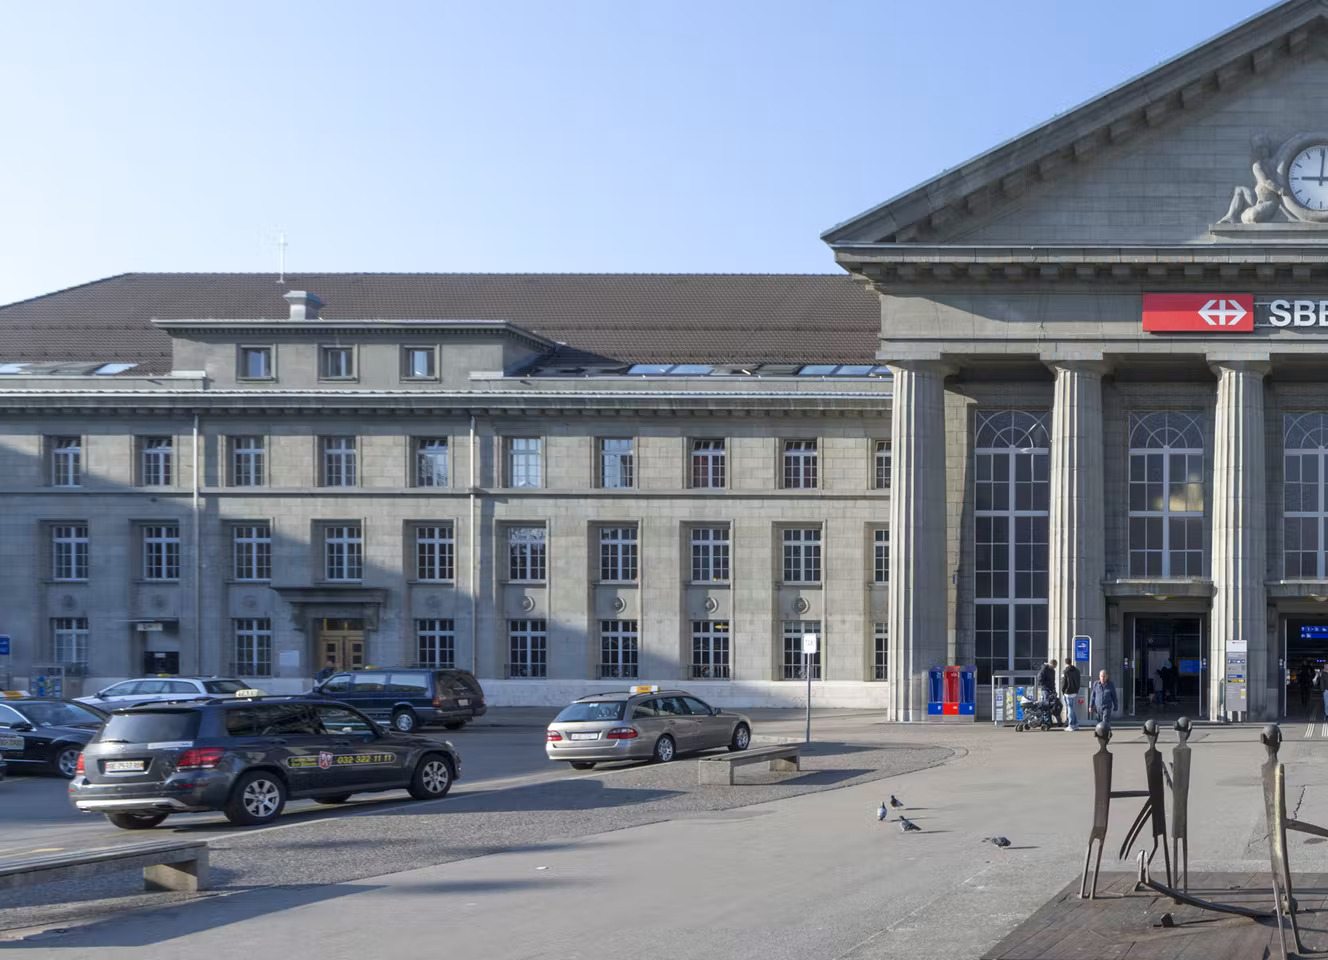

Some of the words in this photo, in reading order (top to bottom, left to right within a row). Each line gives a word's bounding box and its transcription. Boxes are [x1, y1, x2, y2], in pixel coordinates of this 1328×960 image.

[338, 756, 354, 764] 032
[356, 755, 371, 763] 322
[374, 754, 381, 762] 11
